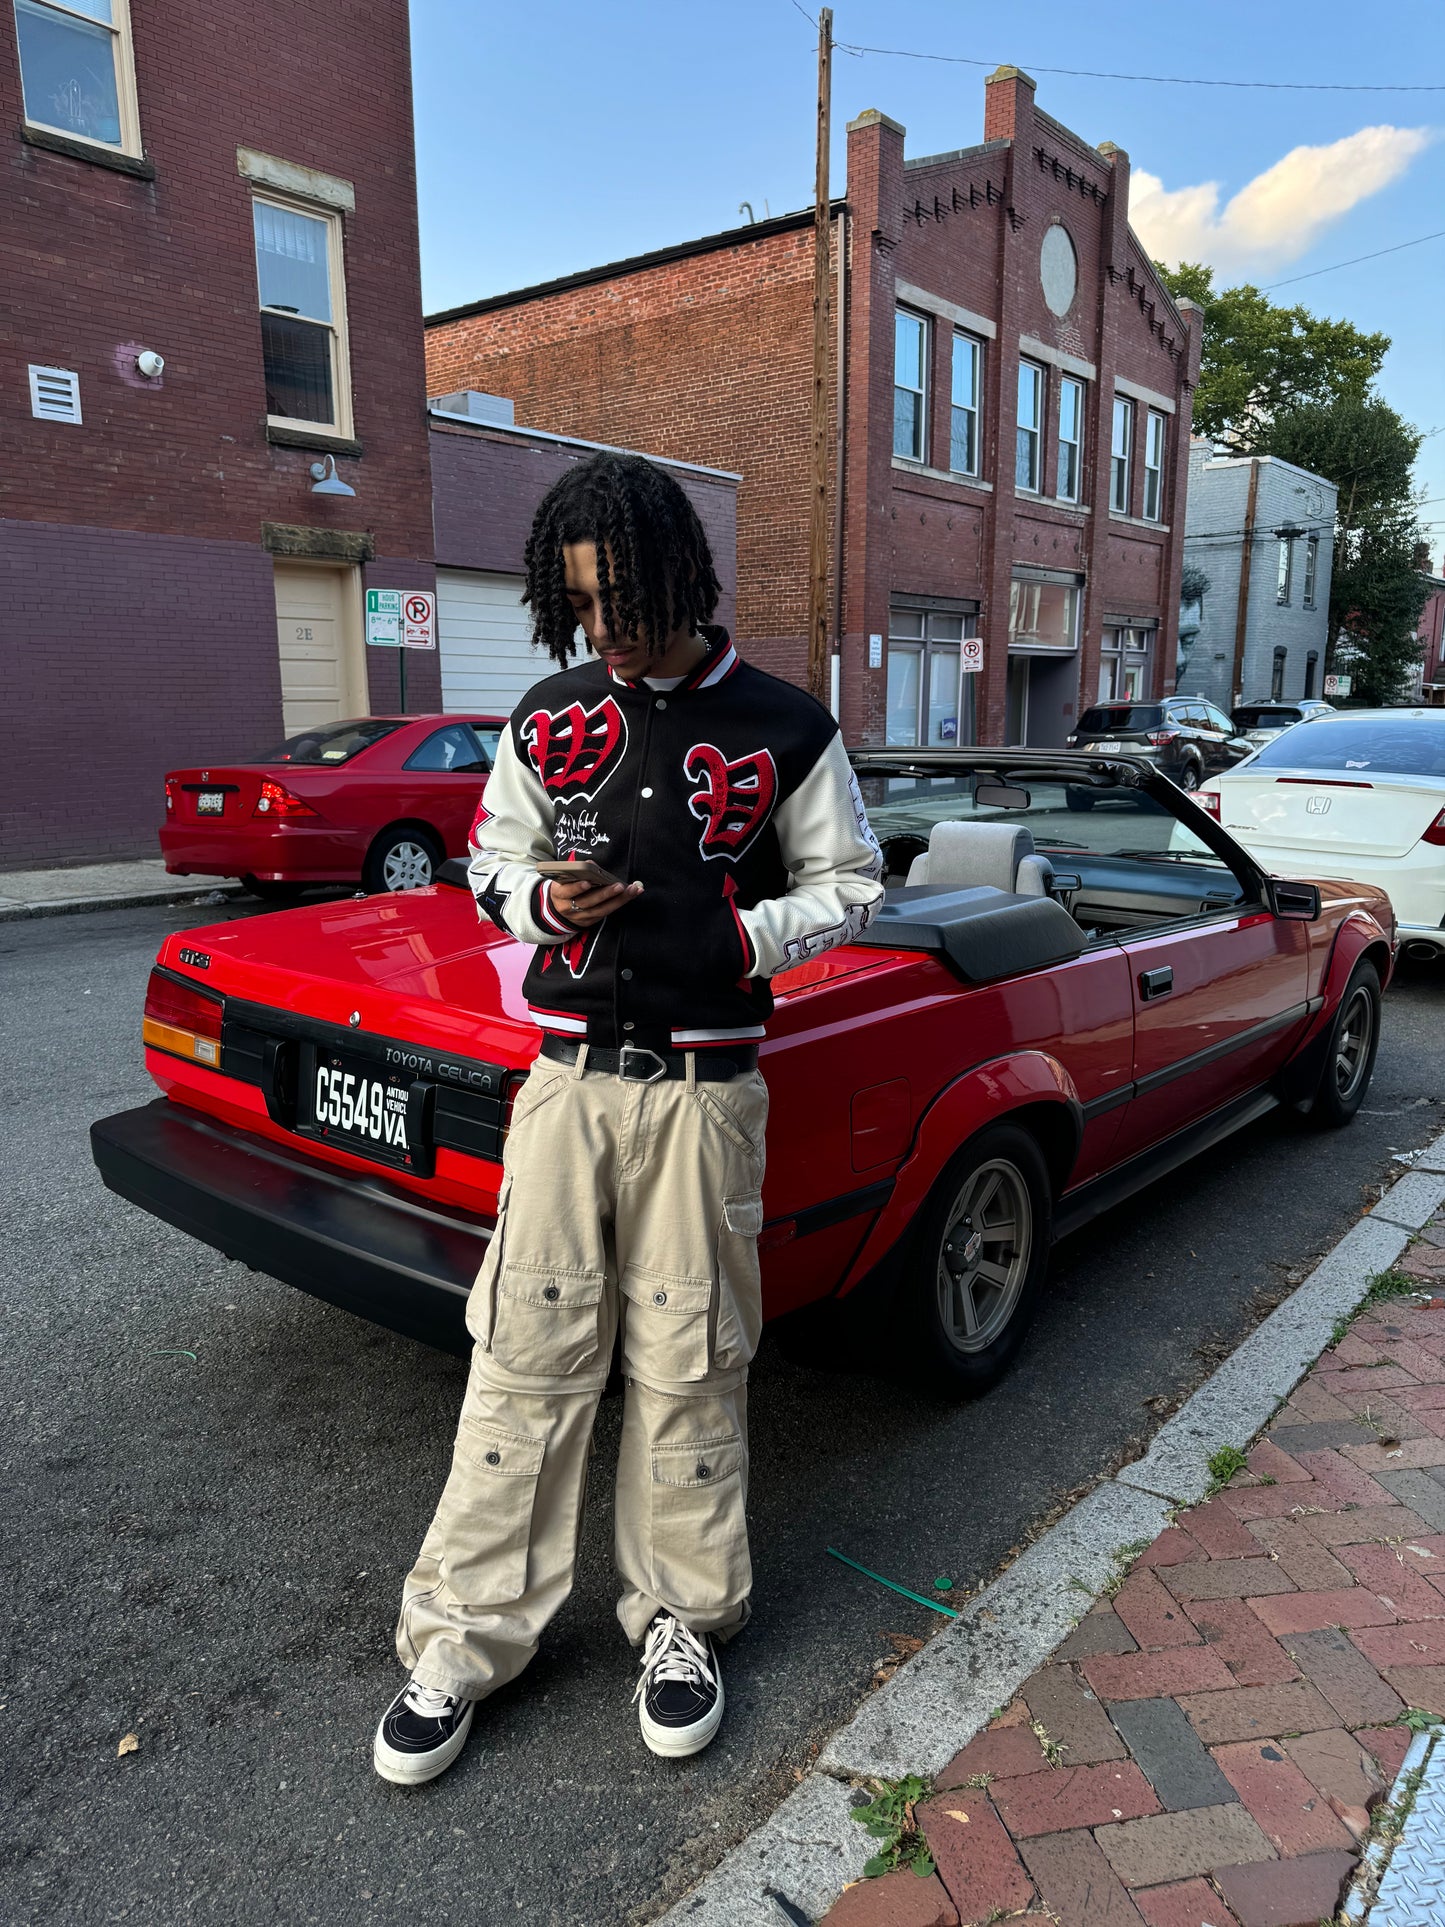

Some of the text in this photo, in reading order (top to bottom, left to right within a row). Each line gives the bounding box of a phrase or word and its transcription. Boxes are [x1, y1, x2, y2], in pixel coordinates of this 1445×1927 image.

[371, 594, 395, 609] 1 HOUR
[380, 602, 398, 611] PARKING
[295, 626, 313, 641] 2E
[386, 1047, 492, 1089] TOYOTA CELICA
[316, 1066, 384, 1140] C5549
